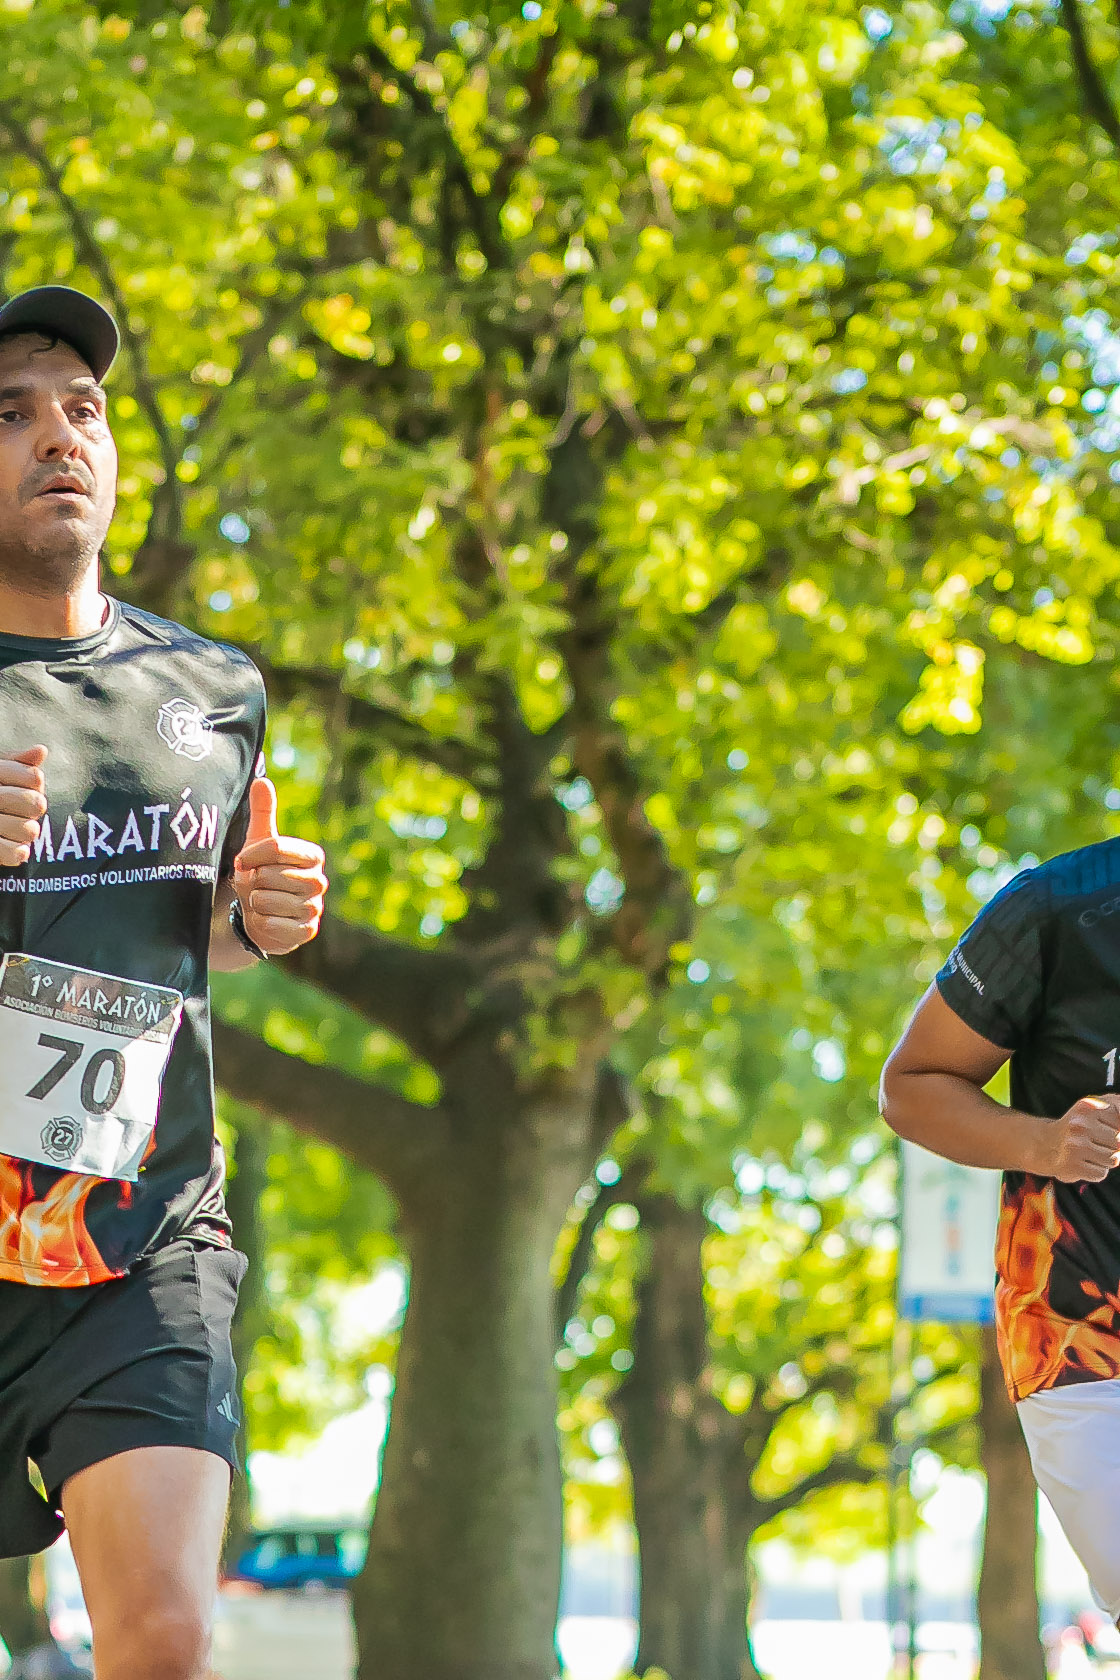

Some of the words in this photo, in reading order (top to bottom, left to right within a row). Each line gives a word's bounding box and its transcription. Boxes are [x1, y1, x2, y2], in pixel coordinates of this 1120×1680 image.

[28, 873, 98, 893] BOMBEROS
[99, 864, 183, 887] VOLUNTARIOS
[956, 951, 985, 996] MUNICIPAL
[55, 981, 161, 1024] MARATÓN
[25, 1032, 126, 1115] 70
[53, 1128, 73, 1147] 27
